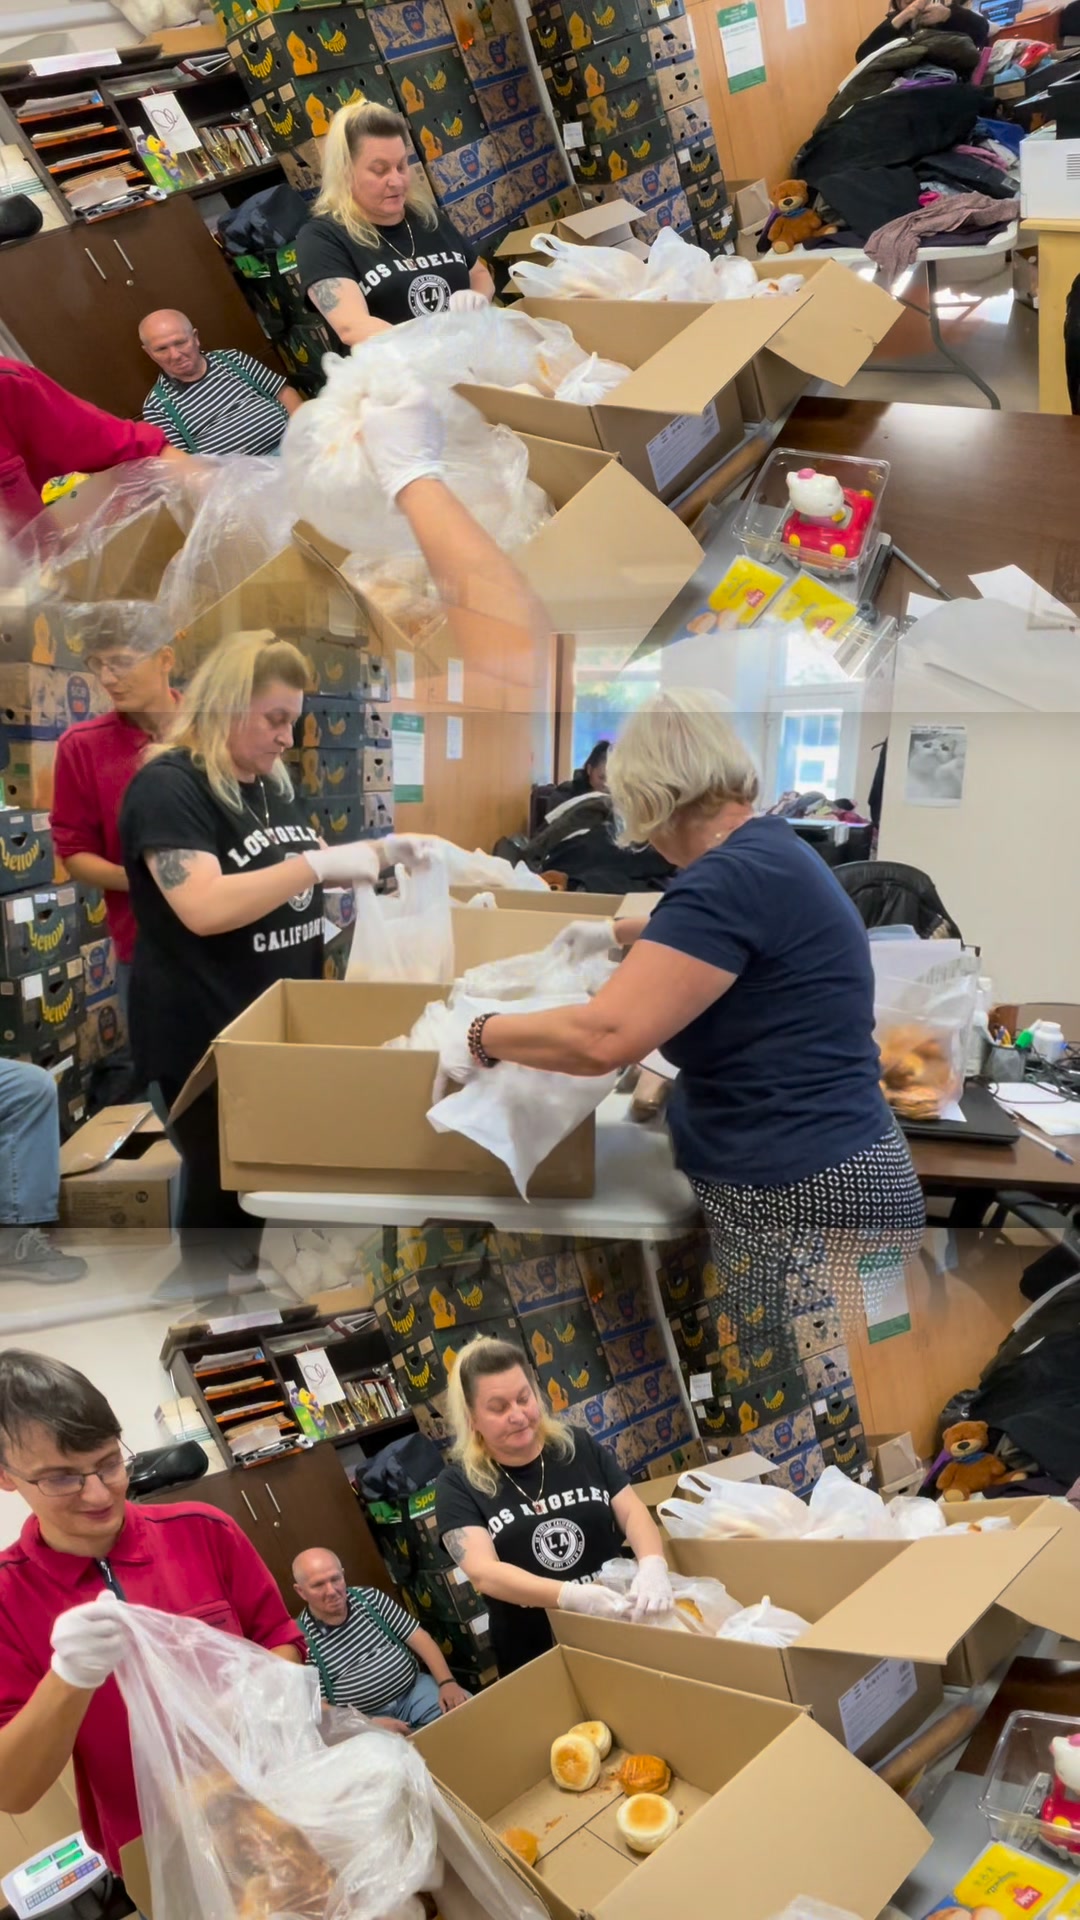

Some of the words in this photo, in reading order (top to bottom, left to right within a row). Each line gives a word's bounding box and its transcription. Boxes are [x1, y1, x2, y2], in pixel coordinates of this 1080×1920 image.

[358, 263, 392, 296] LOS
[393, 251, 467, 272] AGELE
[228, 829, 270, 867] LOS
[415, 1490, 436, 1509] Spo
